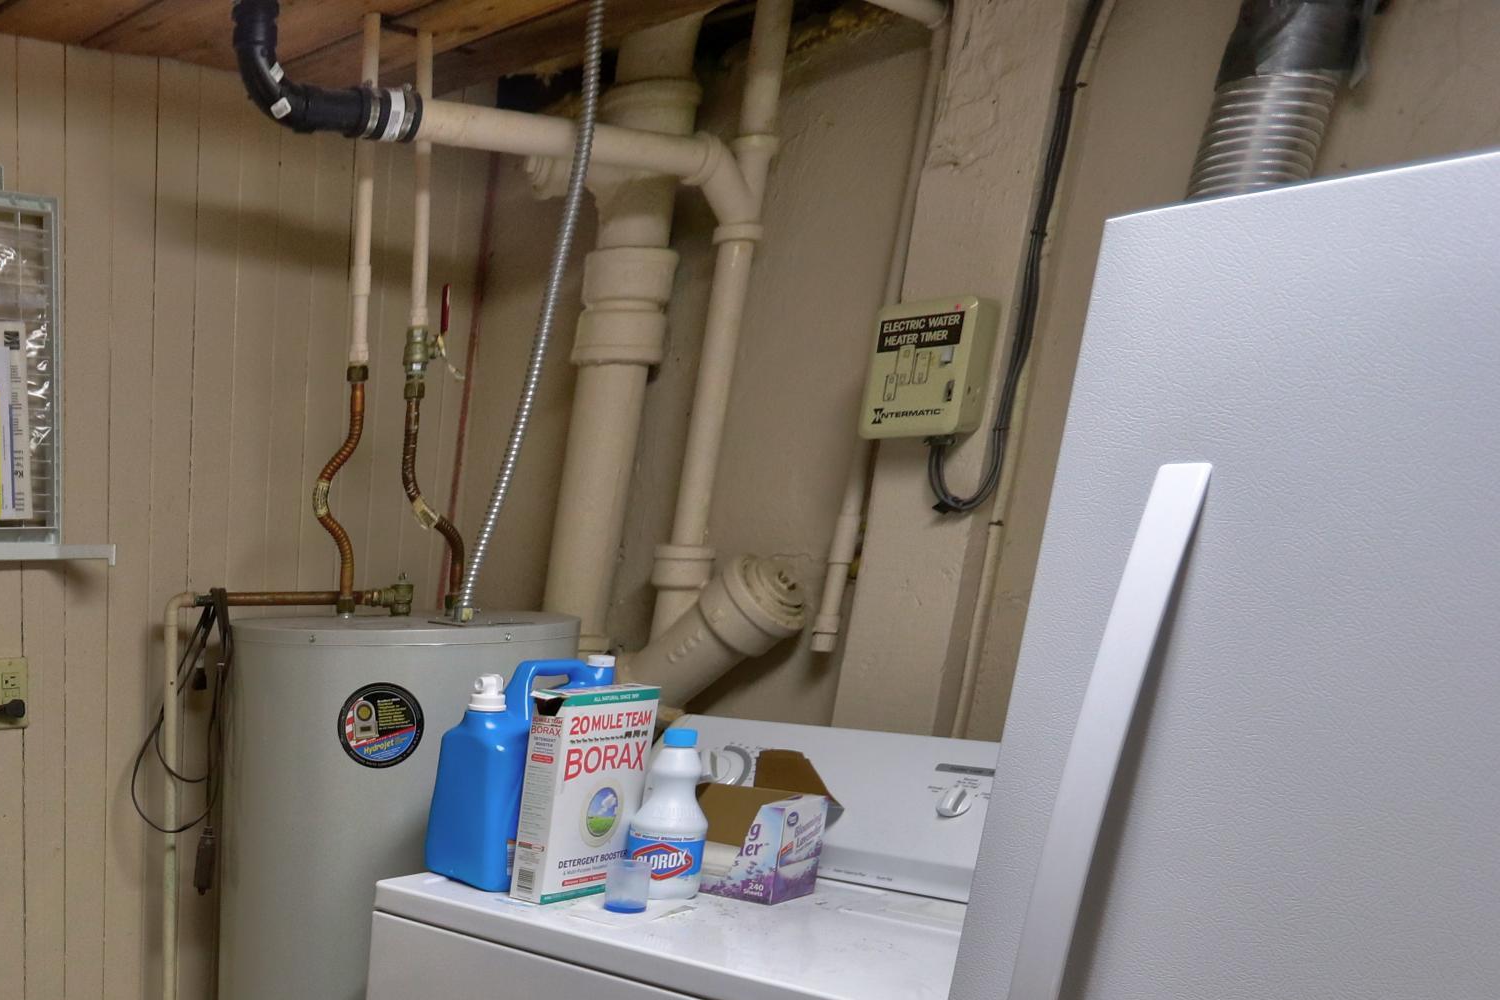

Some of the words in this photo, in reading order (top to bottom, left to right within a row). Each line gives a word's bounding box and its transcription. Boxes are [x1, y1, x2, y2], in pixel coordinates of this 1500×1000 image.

[883, 318, 926, 333] ELECTRIC
[928, 314, 961, 328] WATER
[884, 333, 918, 347] HEATER
[920, 330, 949, 343] TIMER
[531, 725, 561, 737] BORAX
[569, 716, 590, 735] 20
[591, 713, 623, 732] MULE
[625, 710, 653, 727] TEAM
[564, 740, 647, 781] BORAX
[558, 855, 600, 869] DETERGENT
[601, 849, 628, 861] BOOSTER
[748, 882, 764, 891] 240
